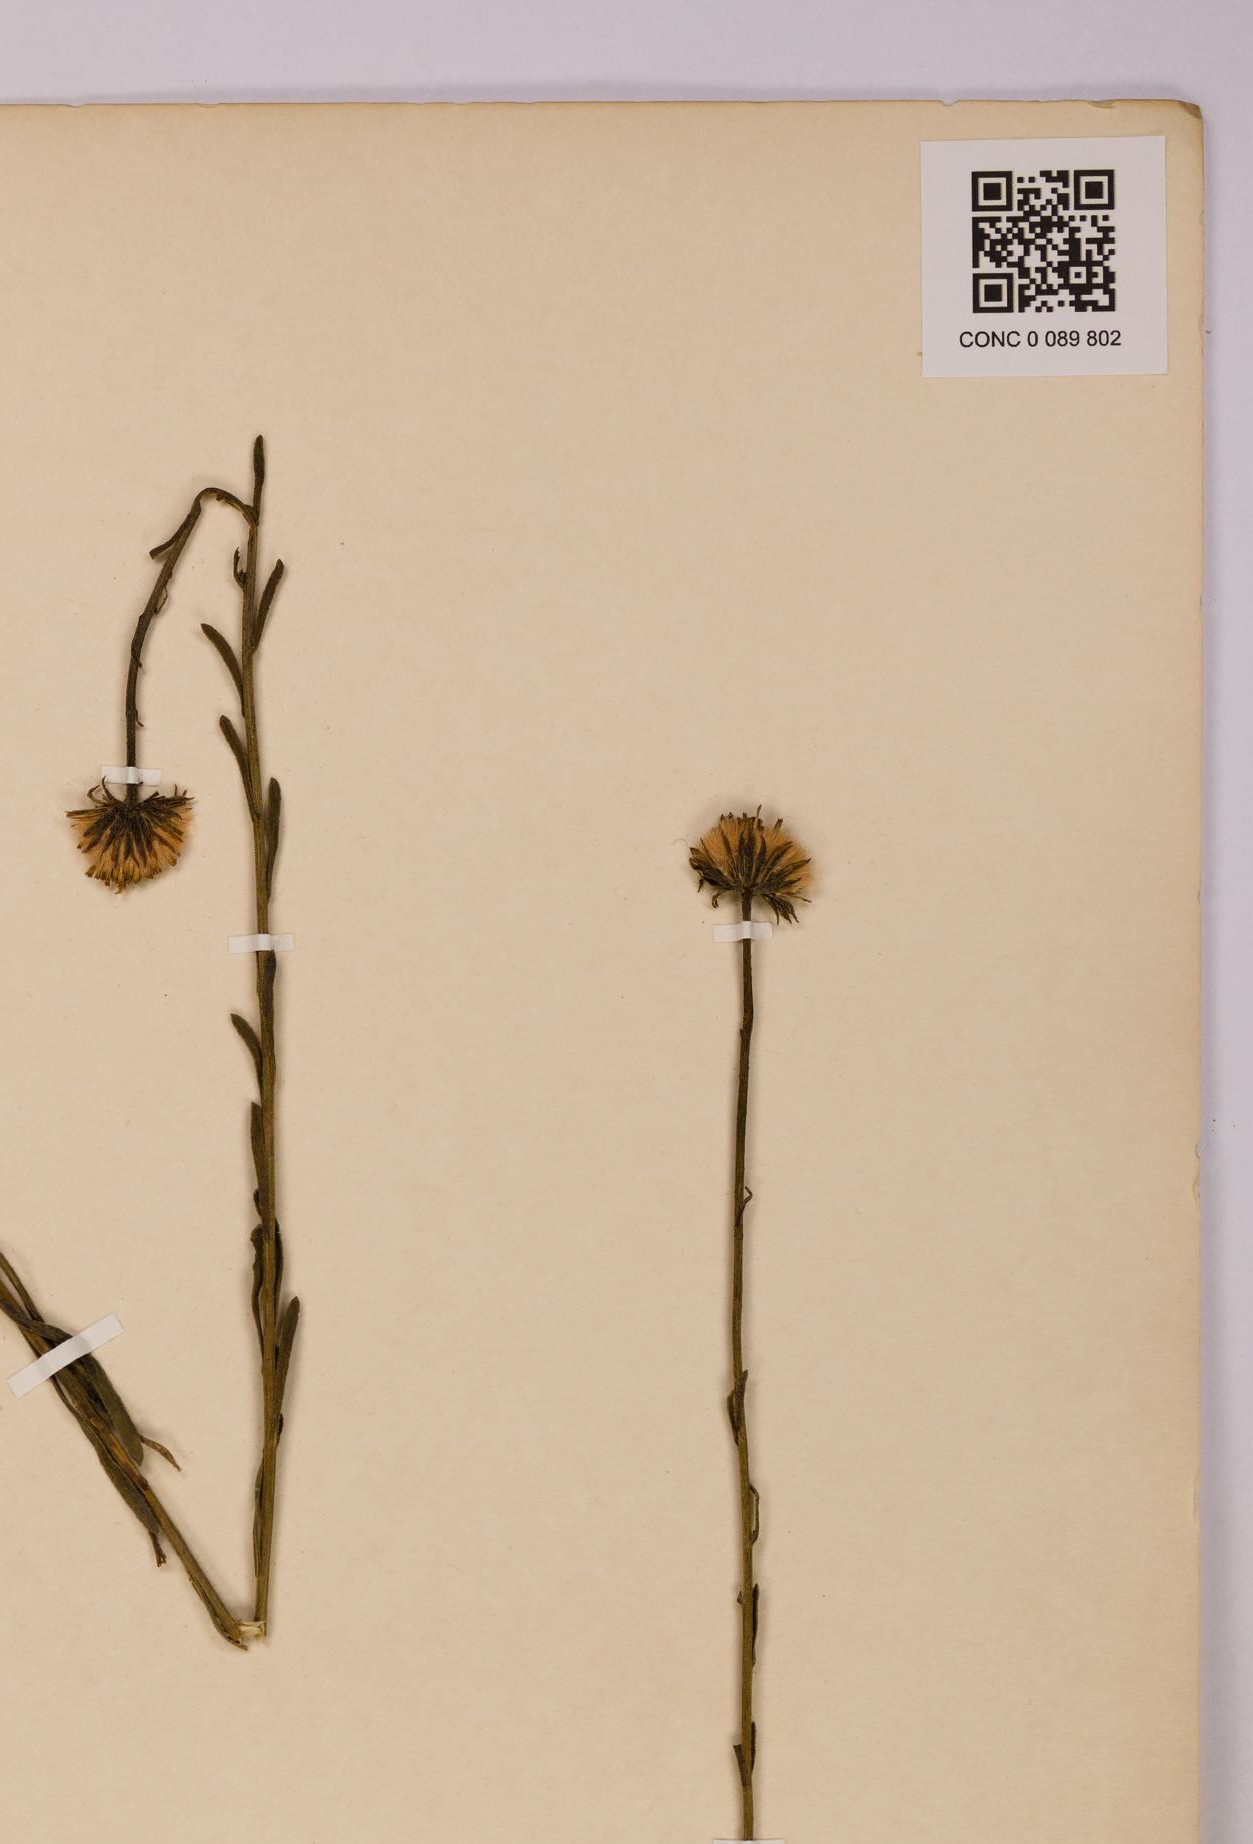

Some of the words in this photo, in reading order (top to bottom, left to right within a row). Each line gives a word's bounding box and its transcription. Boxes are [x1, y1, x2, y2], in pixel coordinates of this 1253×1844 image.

[959, 330, 1021, 348] CONC
[1027, 331, 1039, 348] 0
[1045, 330, 1080, 347] 089
[1087, 330, 1122, 347] 802
